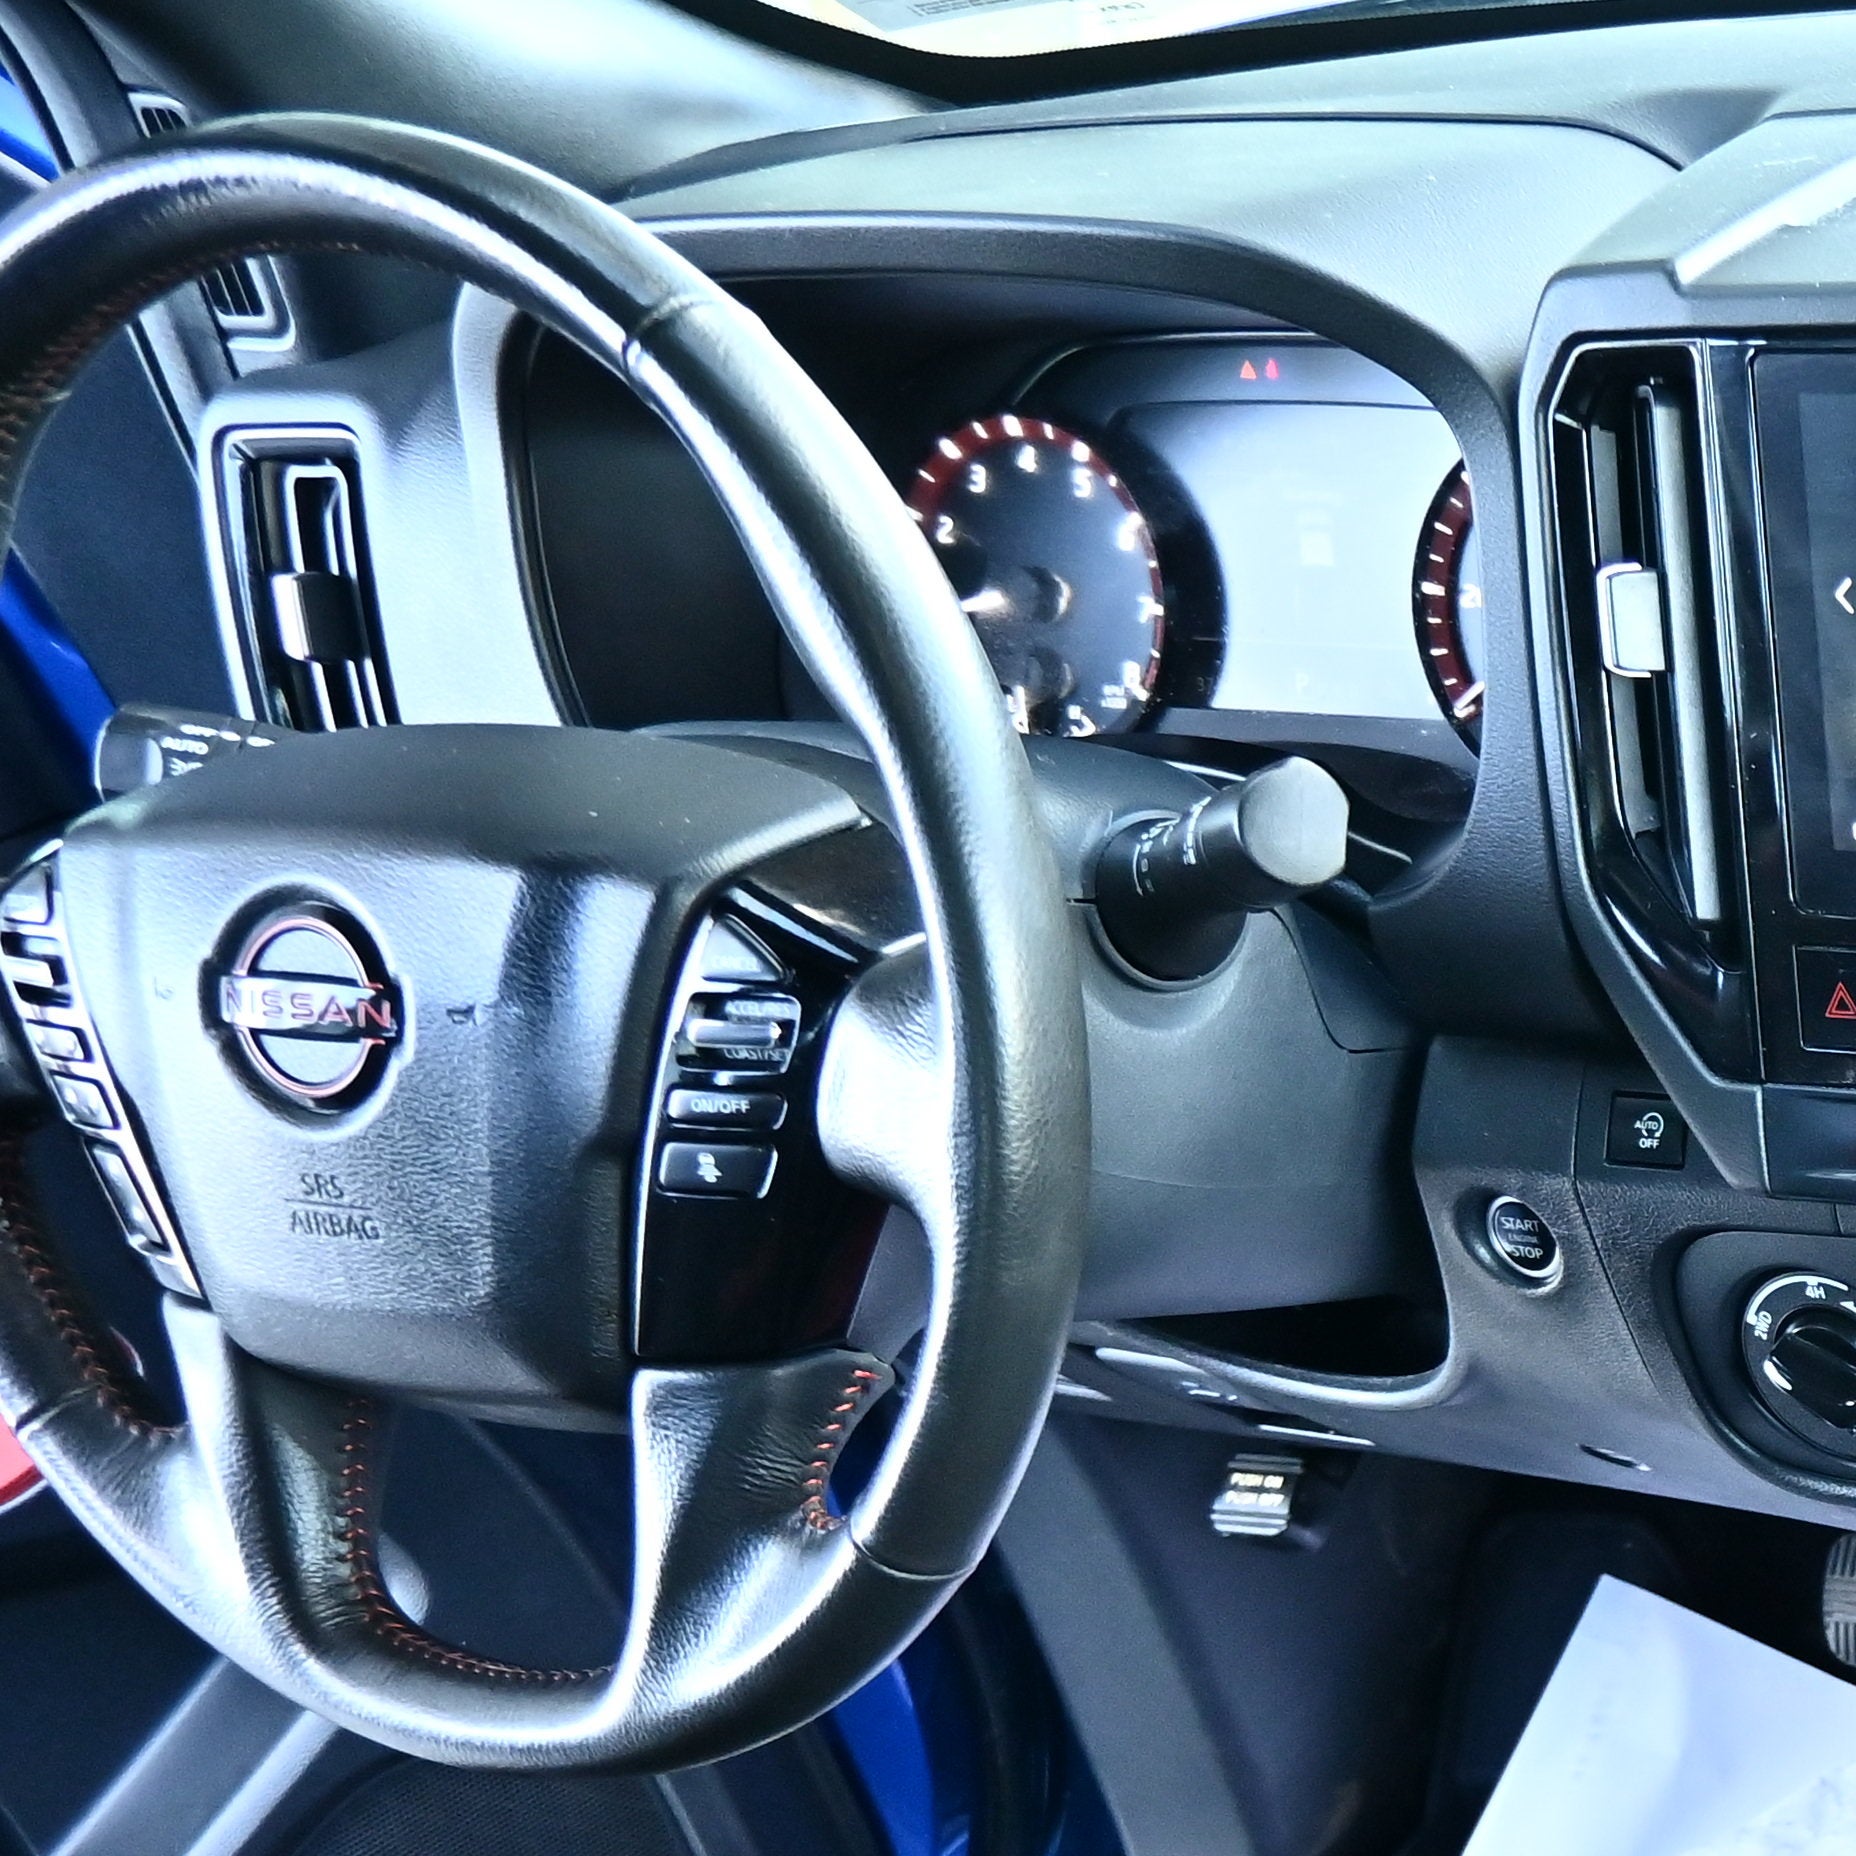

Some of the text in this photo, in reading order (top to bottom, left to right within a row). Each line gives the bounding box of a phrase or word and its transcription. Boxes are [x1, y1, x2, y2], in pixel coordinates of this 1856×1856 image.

[1016, 446, 1036, 473] 4
[967, 463, 987, 494] 3
[1072, 465, 1092, 499] 5
[937, 516, 956, 544] 2
[225, 985, 392, 1030] NISSAN
[690, 1098, 751, 1115] ON/OFF
[1638, 1137, 1661, 1150] OFF
[300, 1172, 345, 1200] SRS
[290, 1210, 381, 1240] AIRBAG
[1499, 1216, 1540, 1233] START
[1510, 1244, 1544, 1260] STOP
[1805, 1286, 1826, 1300] 4H
[1753, 1310, 1774, 1341] 2WD
